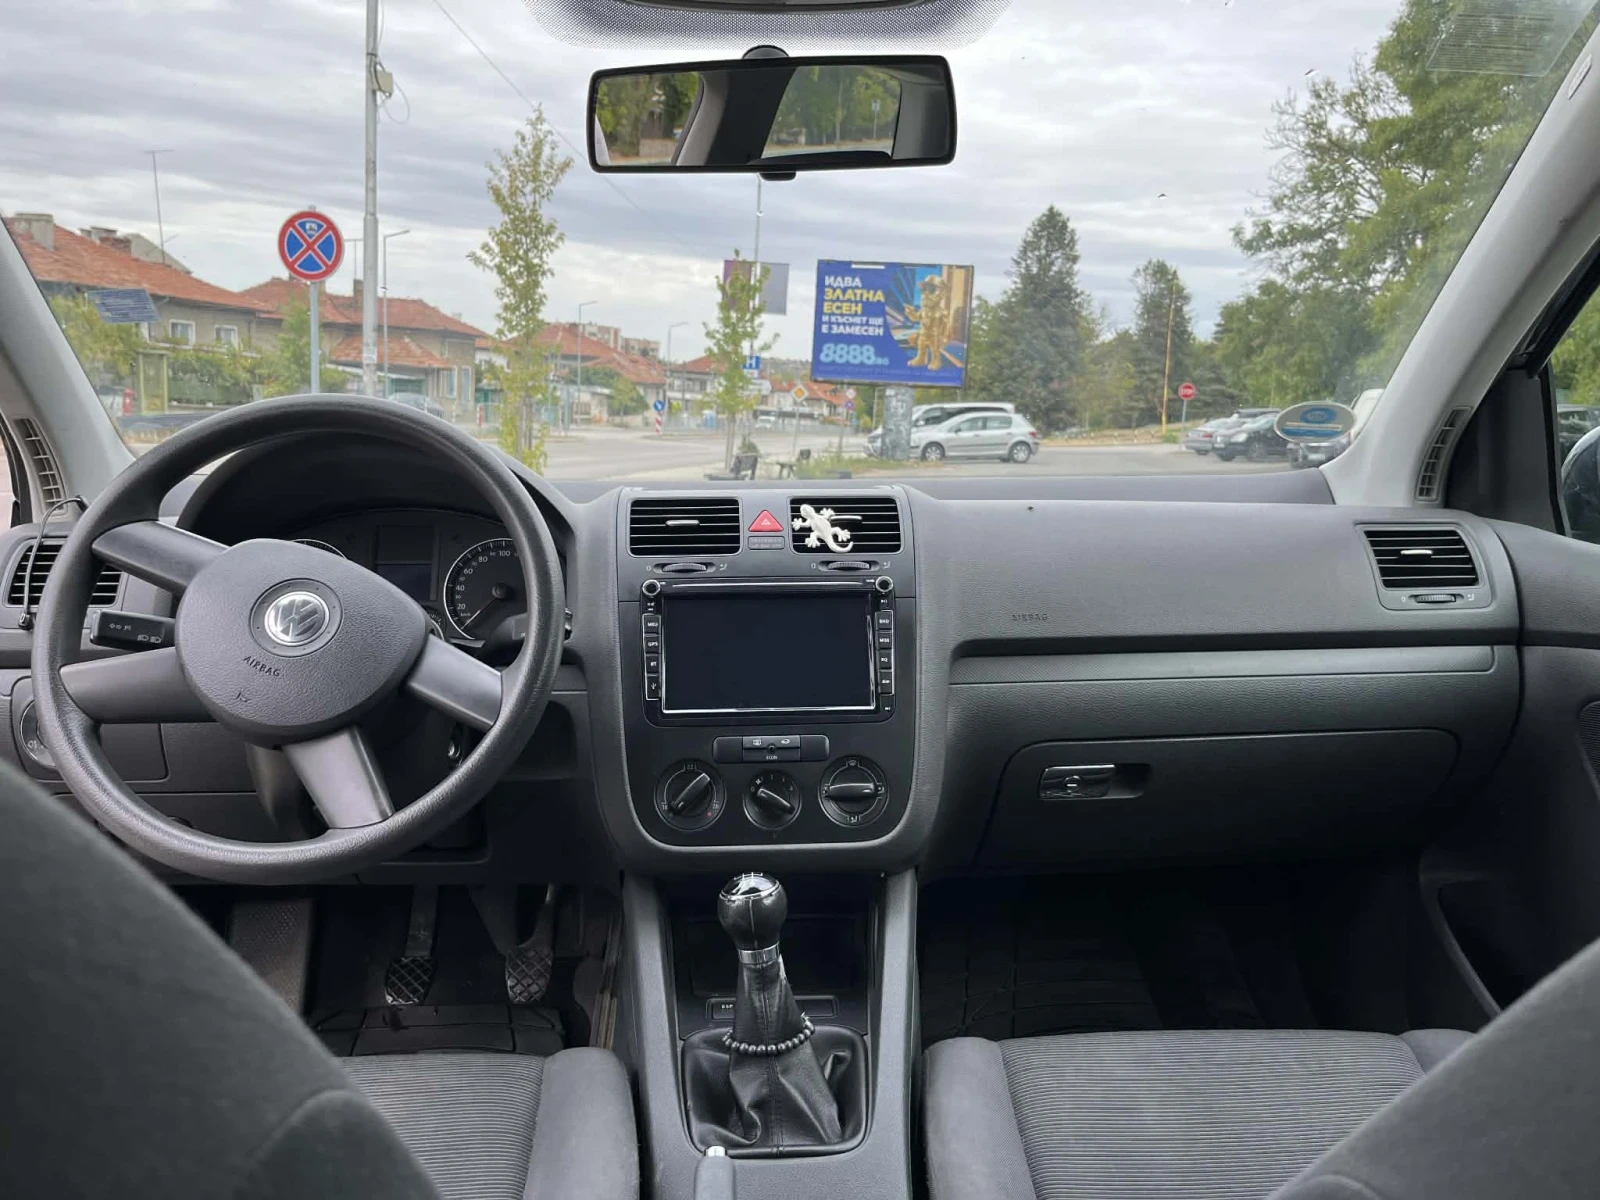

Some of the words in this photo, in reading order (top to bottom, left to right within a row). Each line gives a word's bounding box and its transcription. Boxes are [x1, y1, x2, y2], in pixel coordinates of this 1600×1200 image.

[824, 275, 862, 288] ИДВА
[824, 287, 885, 302] ЗЛАТНА
[823, 301, 862, 314] ЕСЕН
[821, 324, 829, 333] Е
[831, 324, 884, 336] ЗАМЕСЕН
[244, 656, 280, 677] AIRBAG
